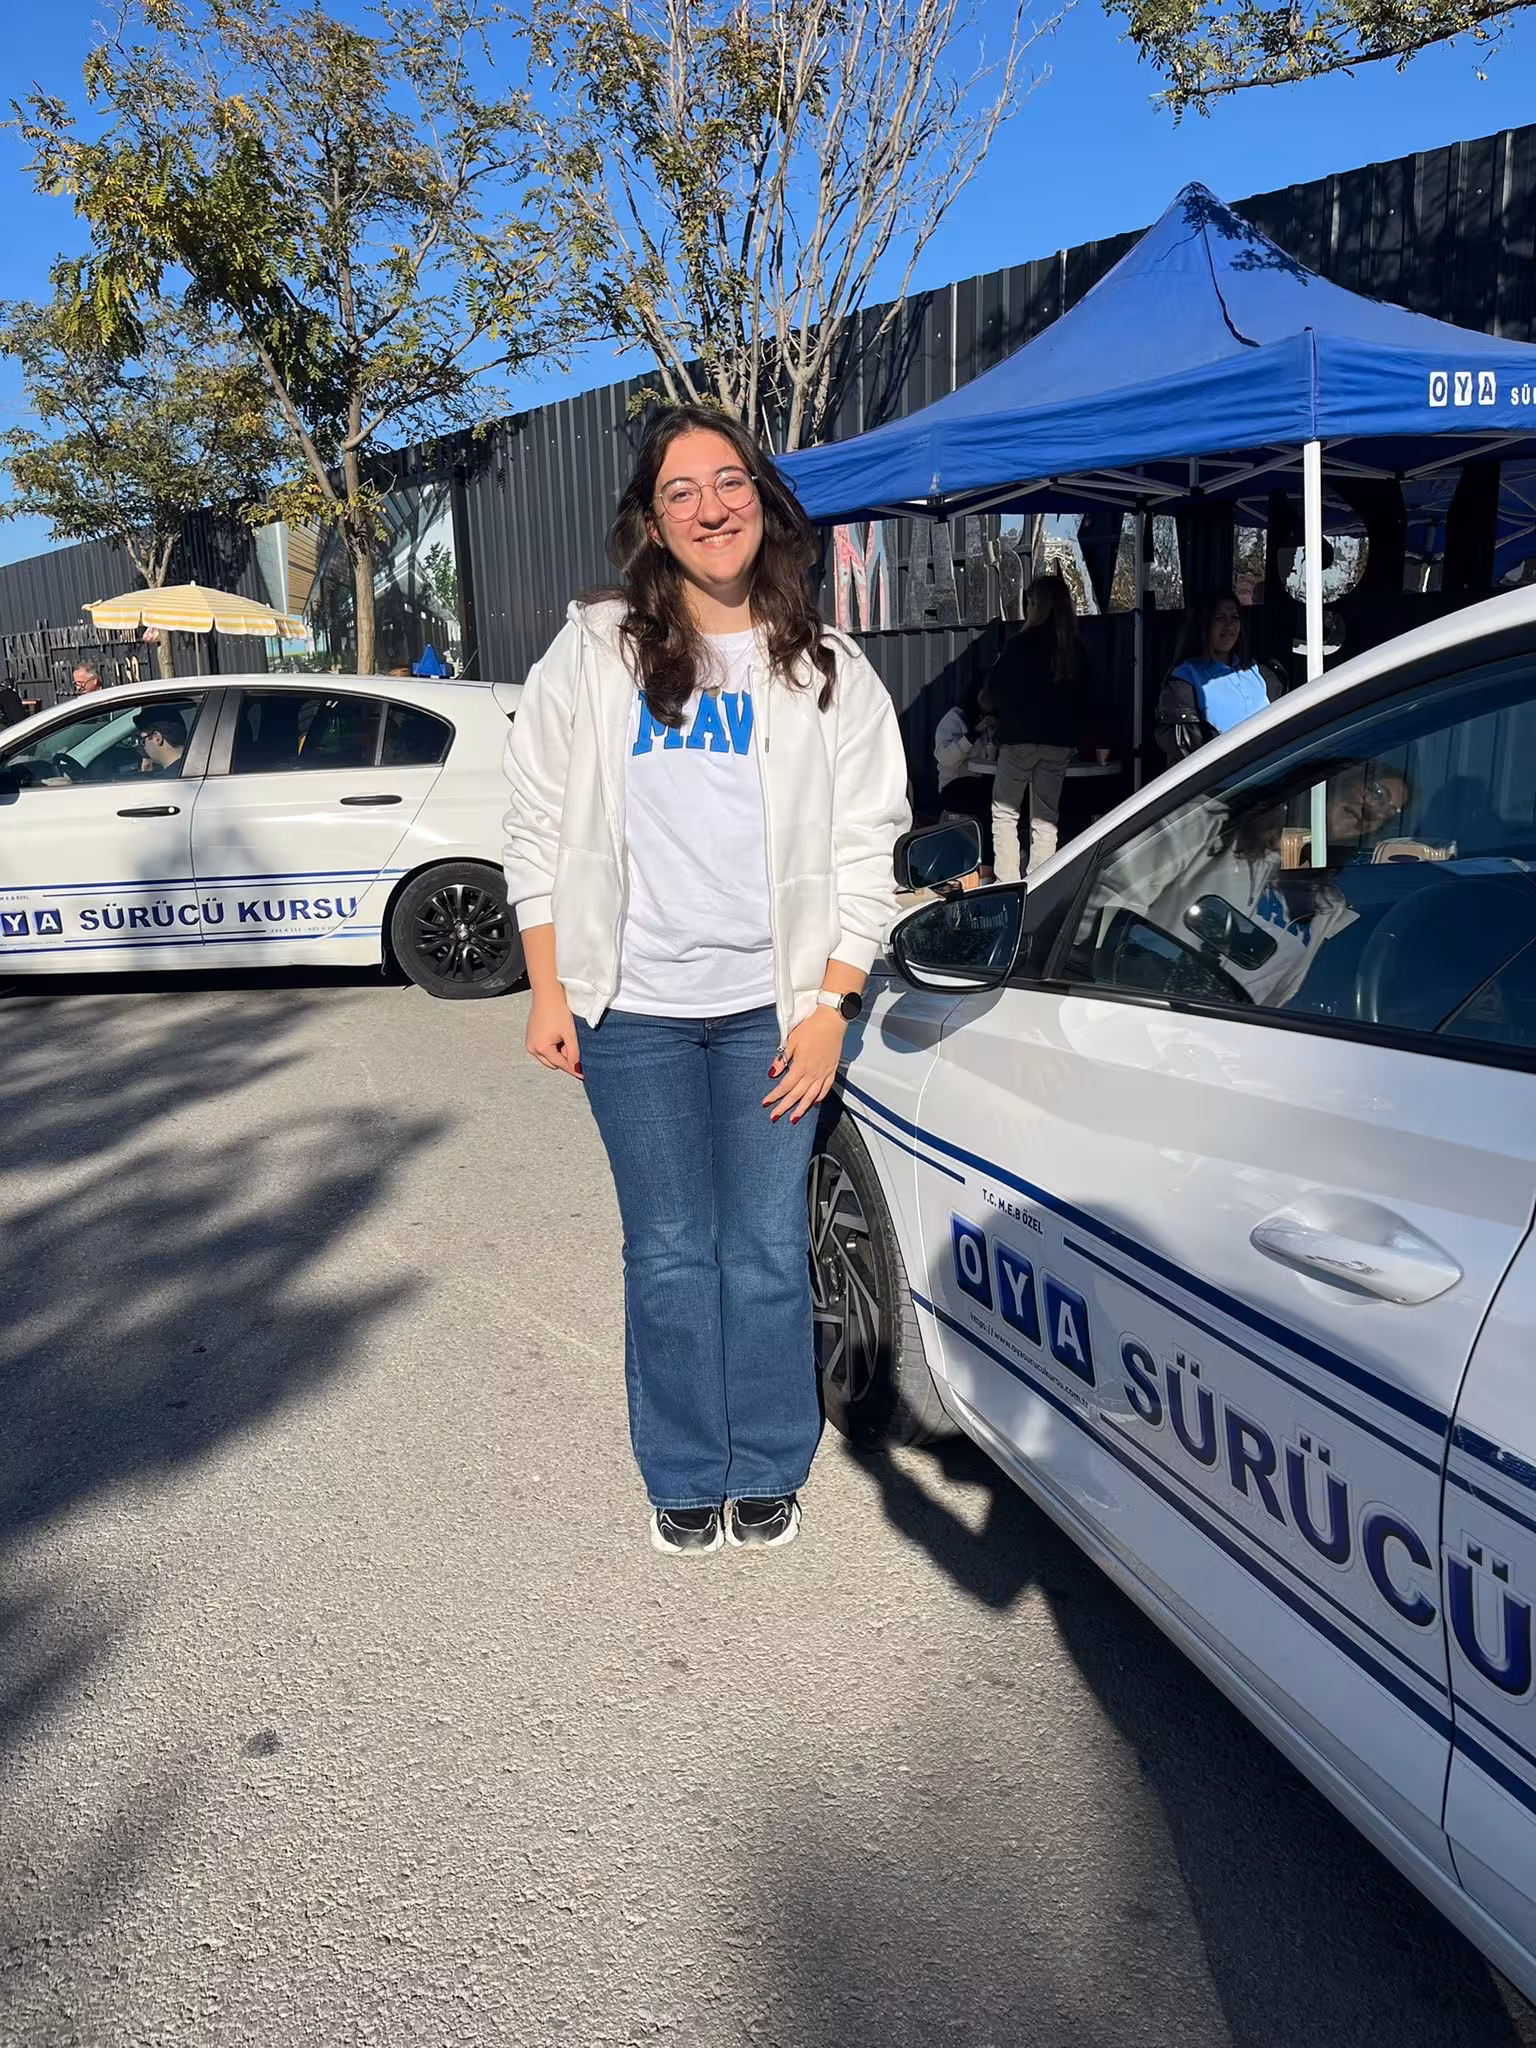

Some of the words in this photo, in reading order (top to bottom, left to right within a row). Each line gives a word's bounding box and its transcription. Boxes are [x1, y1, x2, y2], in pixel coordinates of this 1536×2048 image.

[1431, 374, 1494, 404] OYA
[1510, 383, 1536, 406] SÜ
[79, 897, 225, 931] SÜRÜCÜ
[238, 896, 358, 923] KURSU
[1022, 1208, 1044, 1235] ÖZEL
[956, 1230, 1088, 1367] OYA
[1121, 1339, 1532, 1697] SÜRÜCÜ
